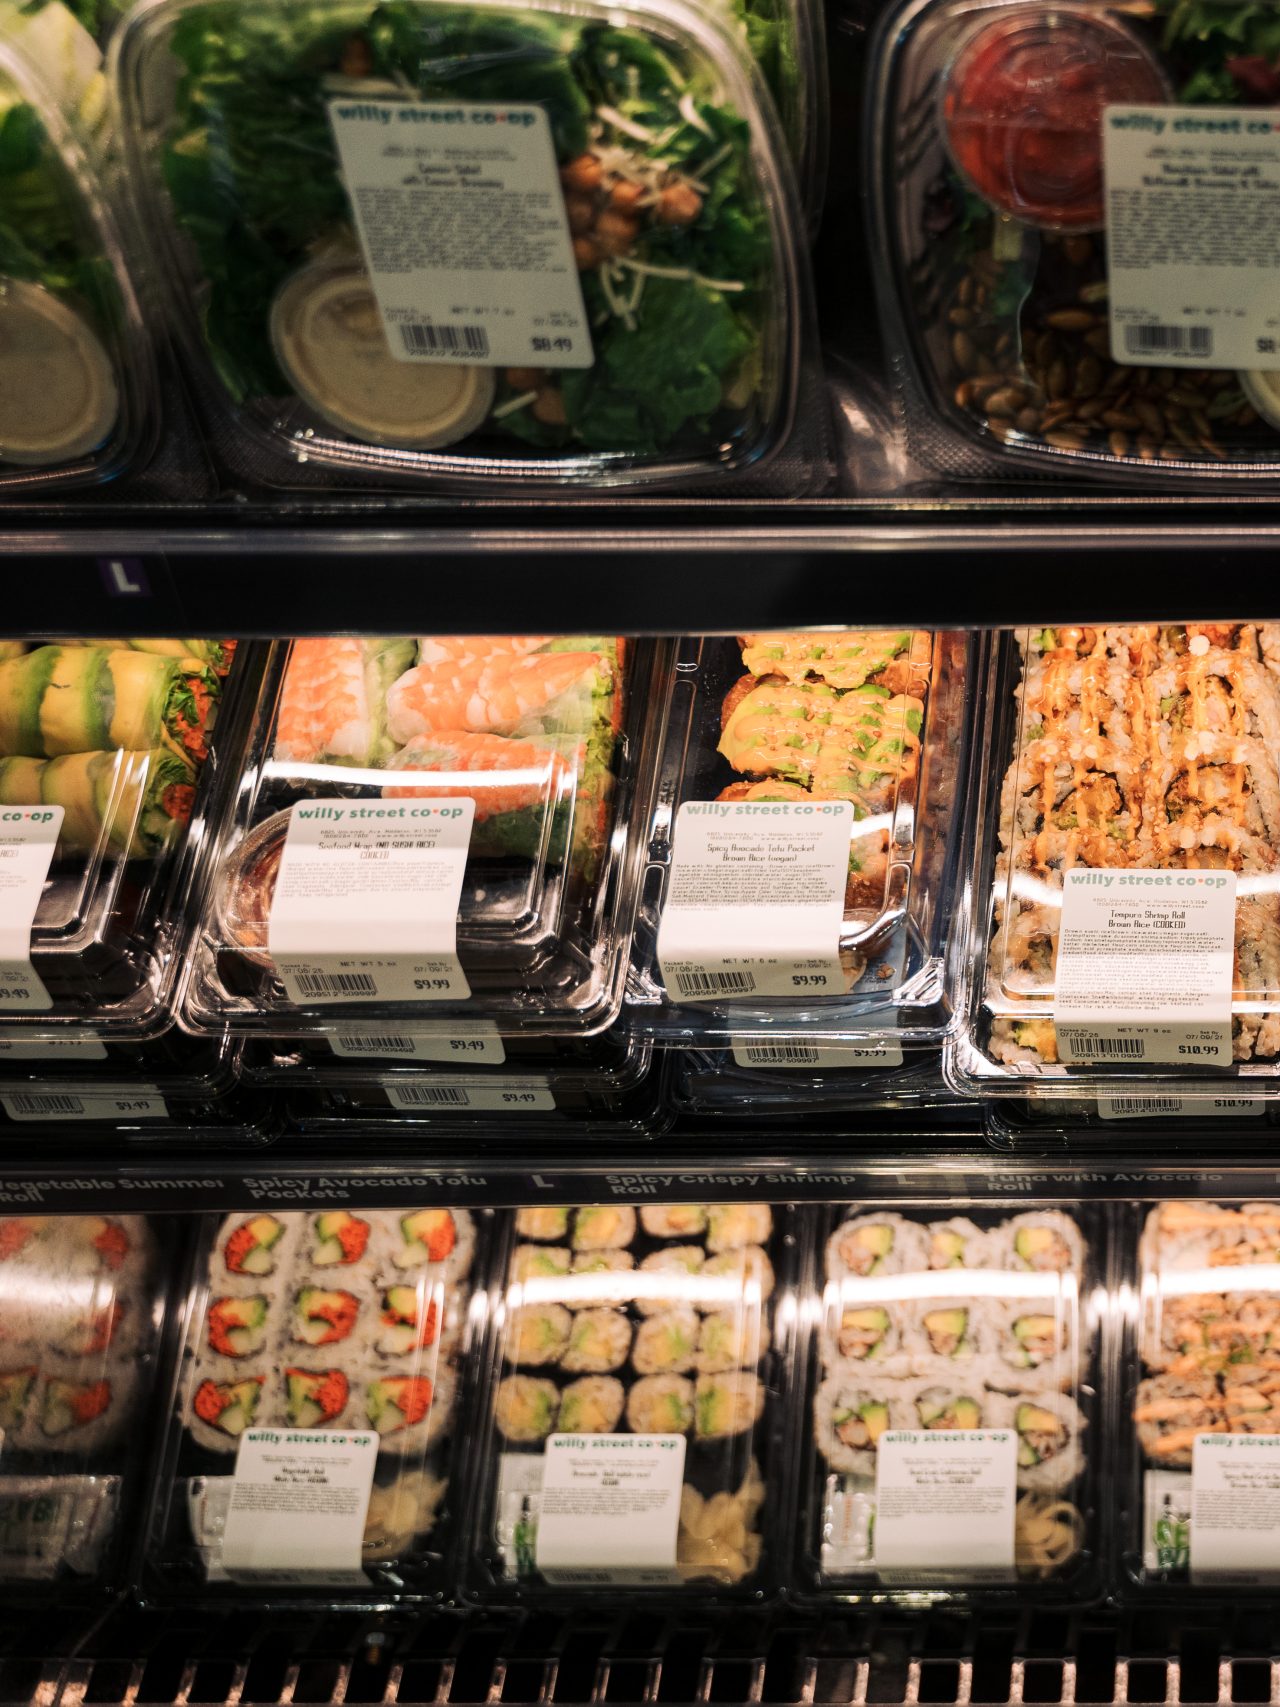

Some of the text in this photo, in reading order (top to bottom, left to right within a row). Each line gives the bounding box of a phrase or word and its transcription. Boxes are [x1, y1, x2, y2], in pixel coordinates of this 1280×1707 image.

[110, 562, 141, 593] L
[299, 808, 344, 821] willy
[350, 808, 405, 819] street
[687, 804, 731, 817] willy
[736, 805, 790, 815] street
[318, 842, 351, 851] Seafood
[707, 843, 815, 853] Spicy Avocado Tofu Packet
[722, 854, 746, 862] Brown
[749, 854, 765, 862] Rice
[1071, 874, 1115, 887] willy
[1119, 875, 1173, 886] street
[1110, 910, 1186, 920] Tempura Shrimp Roll
[1108, 920, 1131, 928] Brown
[1133, 920, 1150, 928] Rice
[414, 979, 450, 990] $9.99
[792, 975, 827, 986] $9.99
[450, 1040, 485, 1051] $9.49
[1178, 1045, 1219, 1056] $10.99
[502, 1093, 535, 1103] $9.49
[116, 1100, 150, 1112] $9.49
[243, 1175, 487, 1190] Spicy Avocado Tofu
[532, 1175, 555, 1188] L
[606, 1173, 856, 1186] Spicy Crispy Shrimp
[1053, 1173, 1107, 1183] with
[1112, 1173, 1222, 1182] Avocado
[611, 1185, 657, 1194] Roll
[987, 1182, 1032, 1191] Roll
[252, 1188, 351, 1199] Pockets
[248, 1433, 280, 1446] willy
[286, 1435, 328, 1444] street
[554, 1437, 587, 1450] willy
[592, 1438, 633, 1448] street
